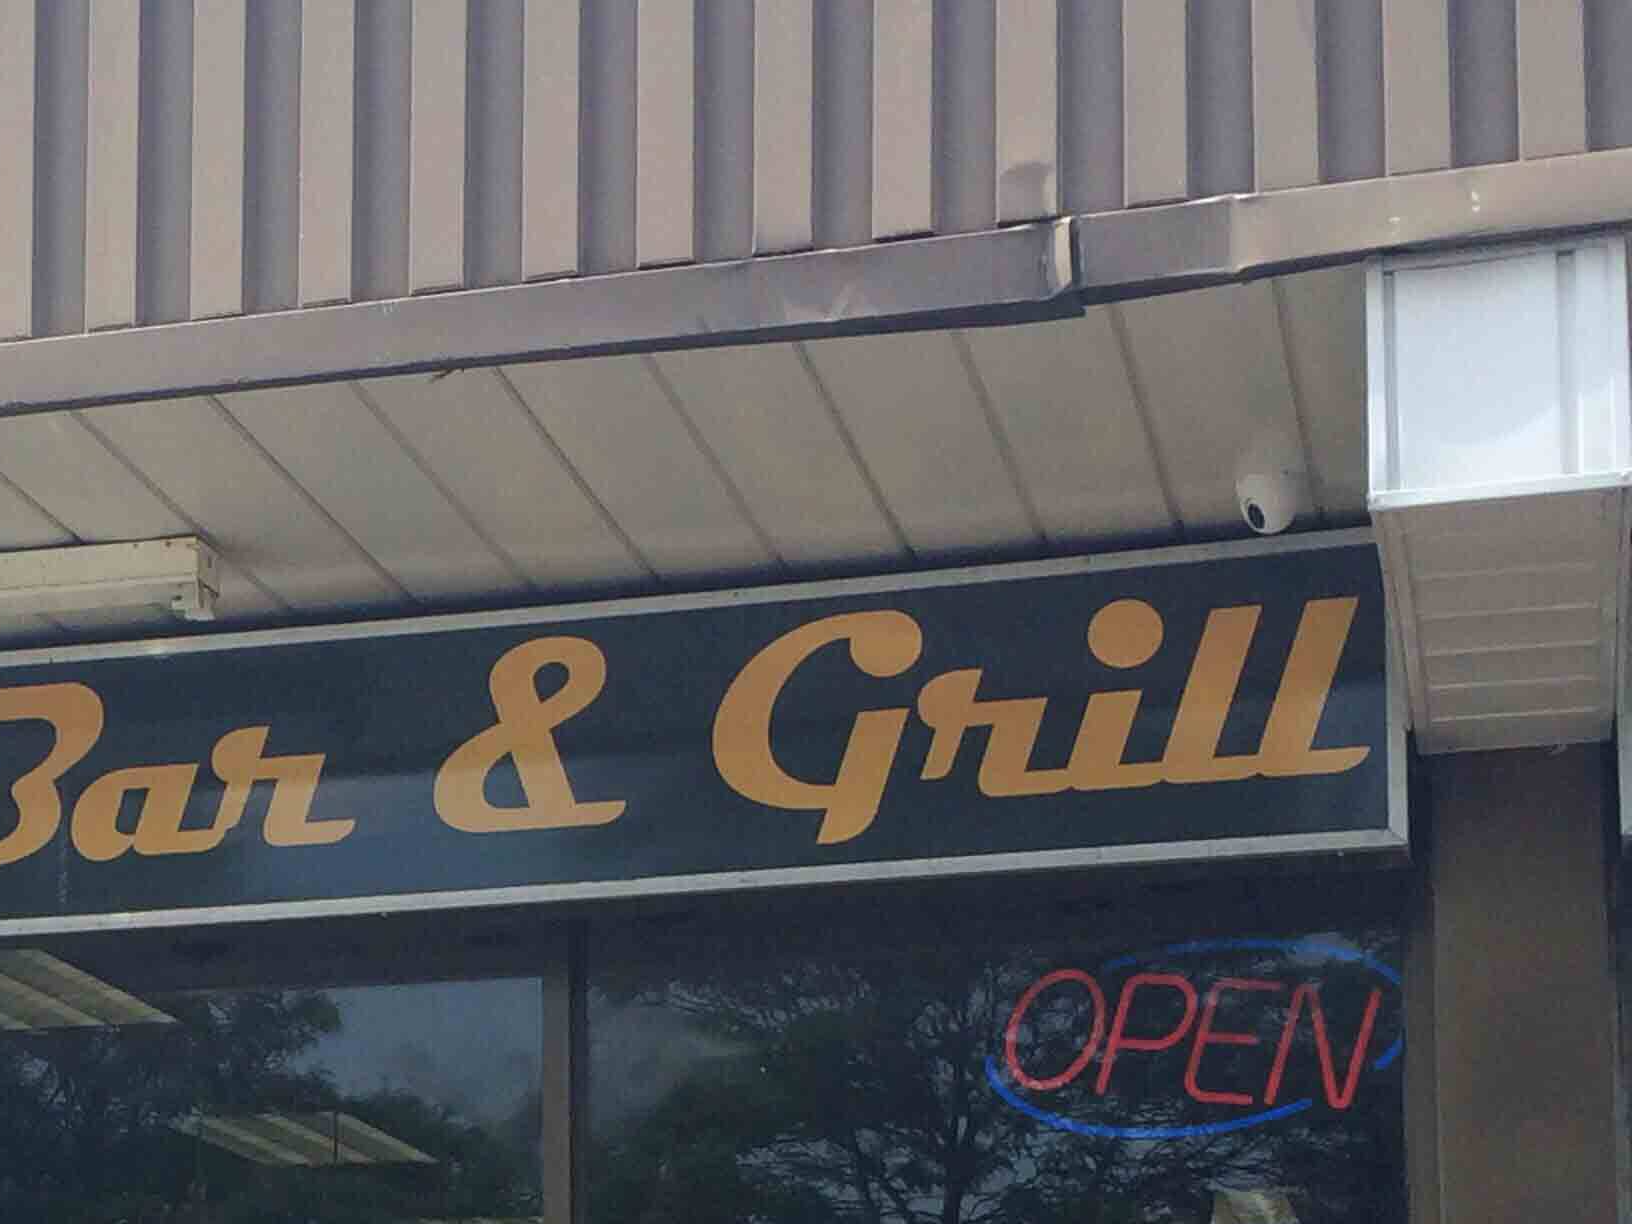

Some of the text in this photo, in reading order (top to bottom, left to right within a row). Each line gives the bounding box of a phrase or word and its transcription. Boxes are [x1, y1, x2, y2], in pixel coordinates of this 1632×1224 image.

[433, 636, 626, 832] &
[711, 596, 1370, 844] Grill
[1006, 969, 1382, 1111] OPEN
